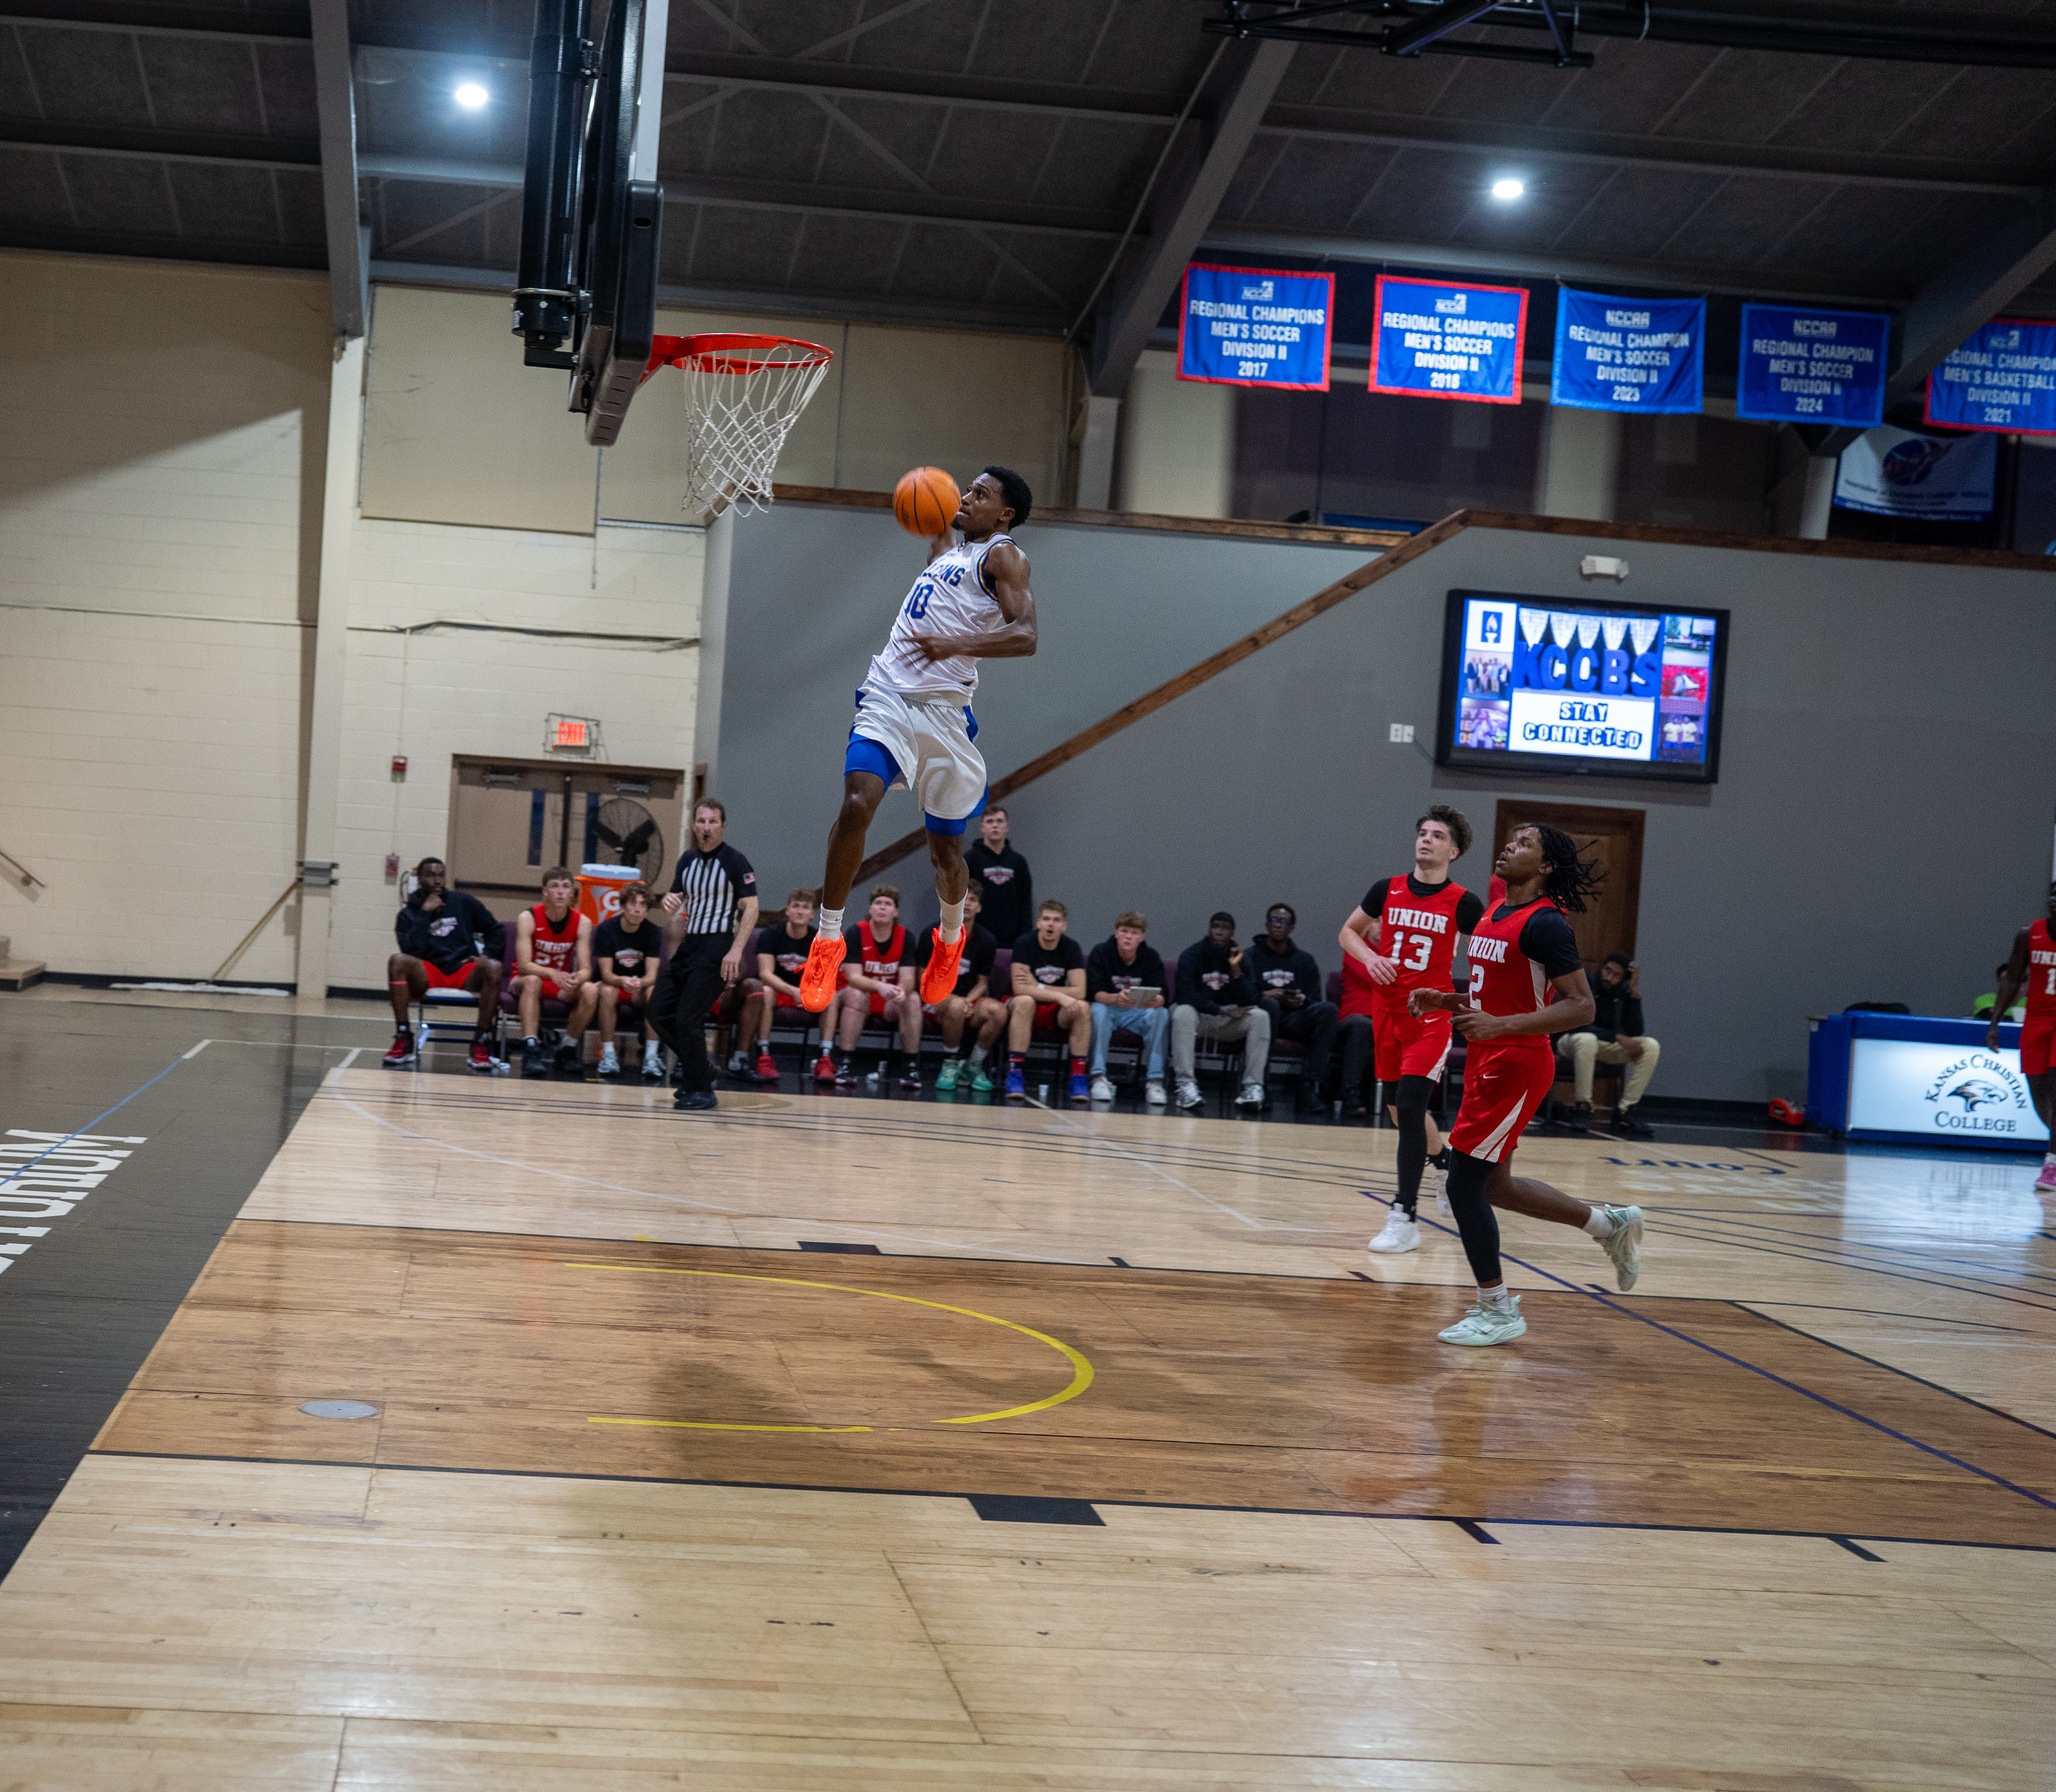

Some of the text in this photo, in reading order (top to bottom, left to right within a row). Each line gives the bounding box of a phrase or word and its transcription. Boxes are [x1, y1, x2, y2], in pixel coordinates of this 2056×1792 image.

[1189, 300, 1325, 325] REGIONAL CHAMPIONS
[1605, 310, 1650, 327] NCCAA
[1211, 321, 1300, 342] MEN'S SOCCER
[1383, 312, 1515, 339] REGIONAL CHAMPIONS
[1569, 325, 1689, 348] REGIONAL CHAMPION
[1793, 319, 1837, 337] NCCAA
[1222, 341, 1287, 360] DIVISION II
[1404, 332, 1492, 355] MEN'S SOCCER
[1753, 339, 1874, 363] REGIONAL CHAMPION
[1414, 352, 1479, 372] DIVISION II
[1586, 346, 1670, 366] MEN'S SOCCER
[1238, 361, 1268, 377] 2017
[1596, 365, 1658, 384] DIVISION II
[1769, 359, 1854, 379] MEN'S SOCCER
[1944, 366, 2055, 389] MEN'S BASKETBALL
[1612, 385, 1640, 402] 2023
[1780, 377, 1842, 395] DIVISION II
[1967, 387, 2031, 406] DIVISION II
[1795, 397, 1823, 413] 2024
[904, 582, 934, 619] 10
[1513, 641, 1658, 696] KCCBS
[1559, 701, 1608, 722] STAY
[557, 722, 586, 745] EXIT
[1523, 722, 1643, 750] CONNECTED
[1387, 907, 1449, 935] UNION
[1390, 930, 1433, 972] 13
[1467, 935, 1509, 964] NION
[1469, 964, 1485, 1010] 2
[1925, 1054, 2027, 1109] KANSAS CHRISTIAN
[1935, 1111, 2017, 1133] COLLEGE
